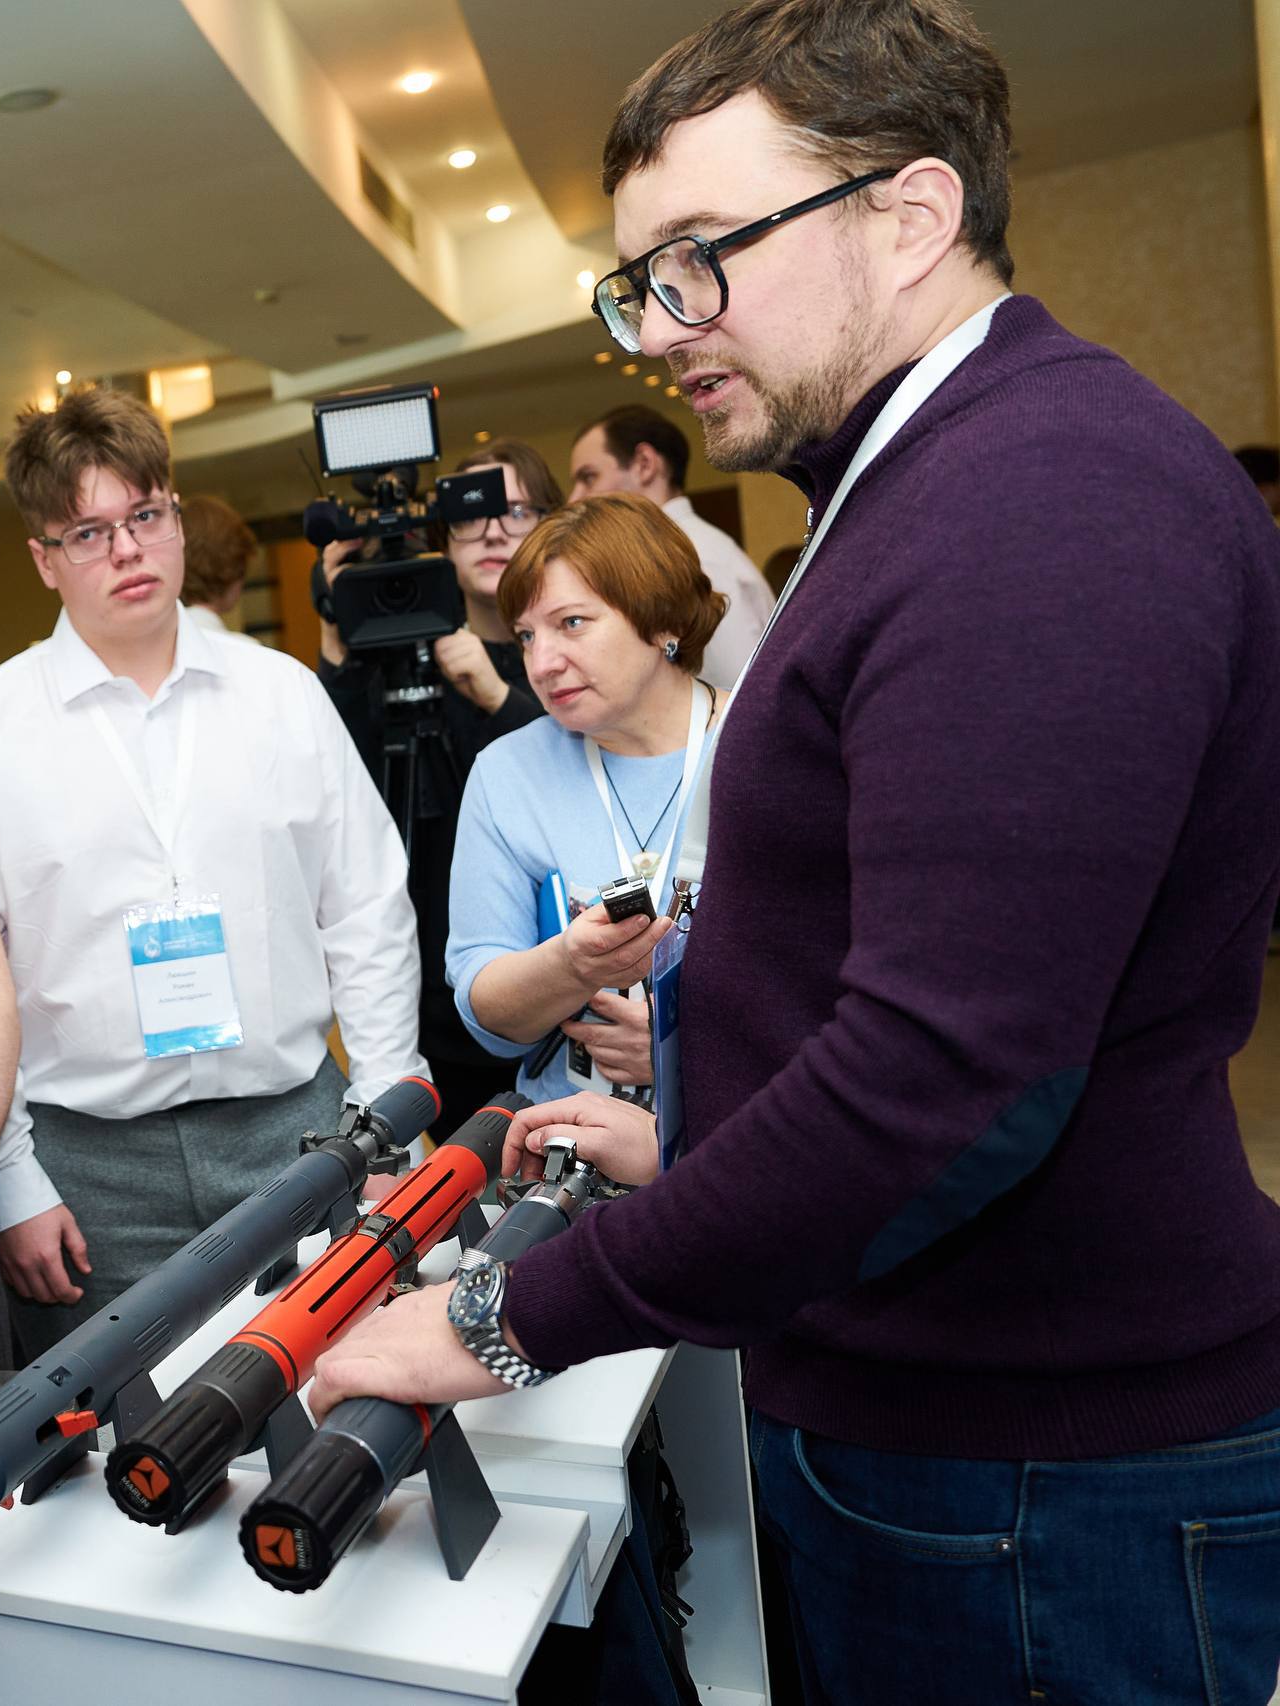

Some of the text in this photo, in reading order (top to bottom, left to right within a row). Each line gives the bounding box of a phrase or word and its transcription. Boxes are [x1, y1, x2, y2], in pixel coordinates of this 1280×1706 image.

[463, 488, 484, 500] 4K
[120, 1476, 150, 1507] MARLIN
[294, 1528, 307, 1569] MARLIN
